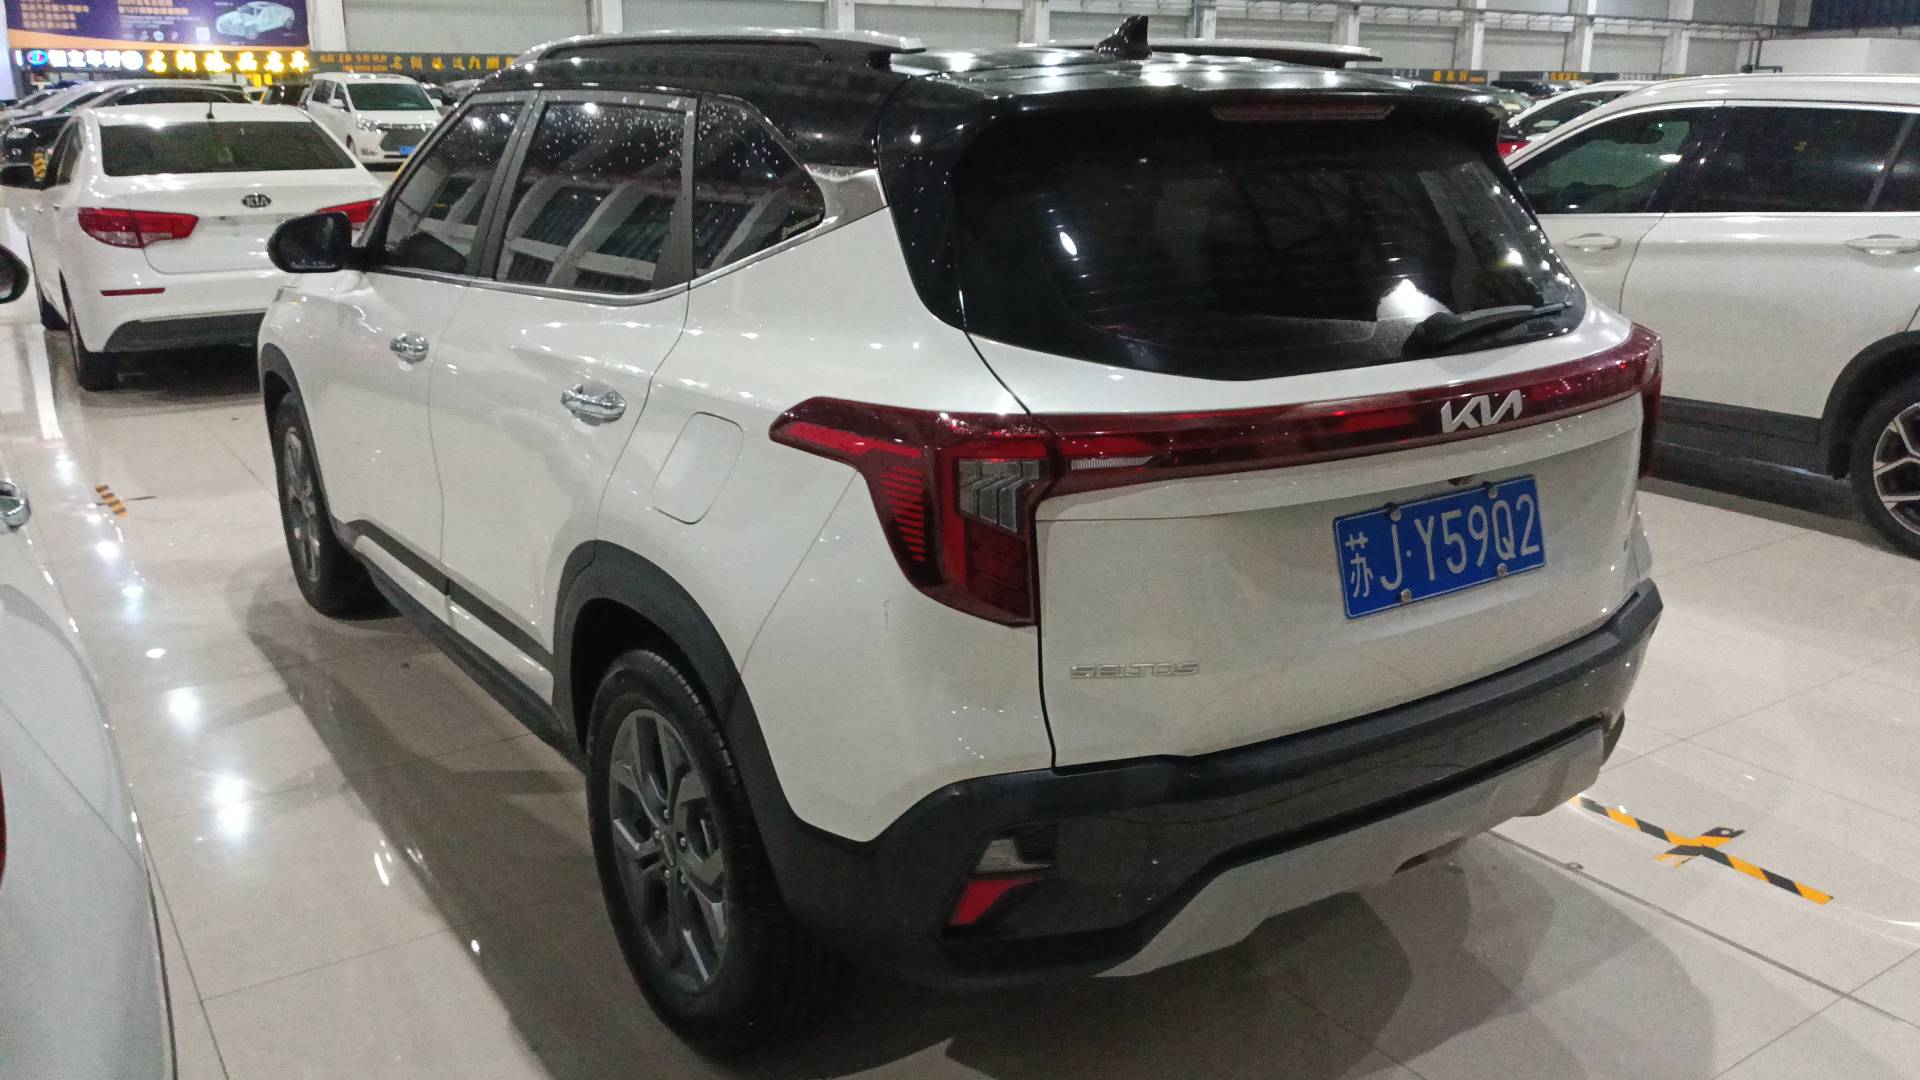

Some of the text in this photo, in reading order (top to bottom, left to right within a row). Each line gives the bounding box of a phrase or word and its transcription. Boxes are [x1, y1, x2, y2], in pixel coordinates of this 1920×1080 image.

[244, 195, 271, 208] KIA
[1441, 389, 1523, 433] KIA
[1070, 661, 1200, 679] SELTOS
